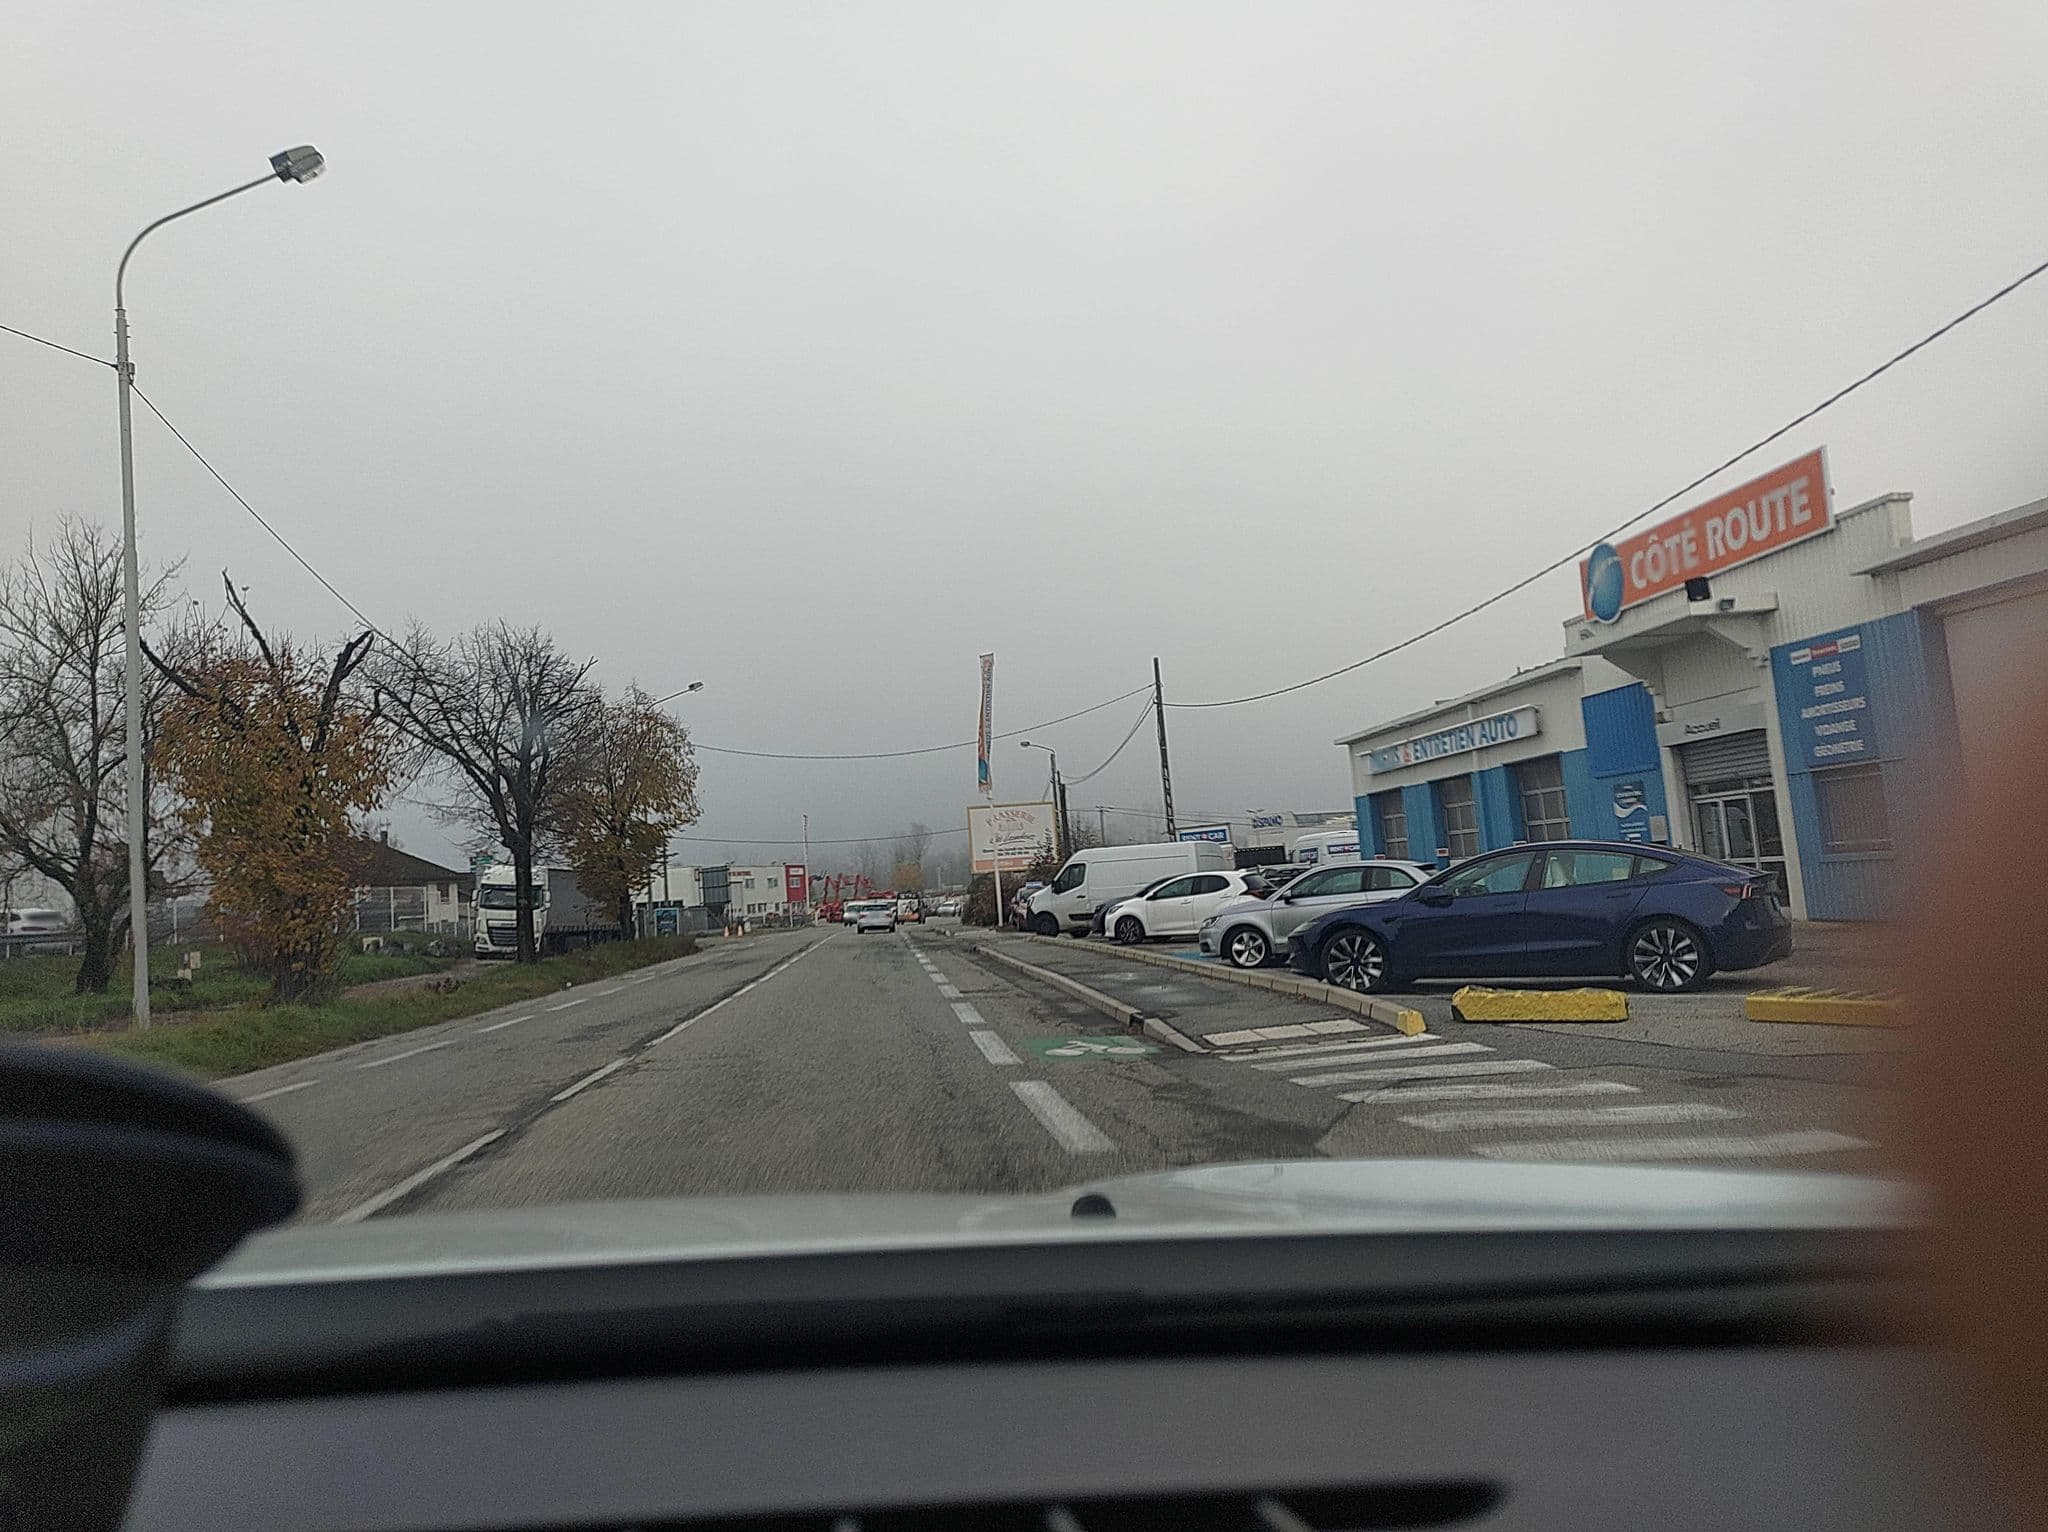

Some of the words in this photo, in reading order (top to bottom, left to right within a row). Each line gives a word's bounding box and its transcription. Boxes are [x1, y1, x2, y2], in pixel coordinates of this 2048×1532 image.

[1630, 519, 1698, 590] CÔTÉ
[1705, 475, 1812, 561] ROUTE
[1685, 718, 1720, 734] Accueil
[1815, 720, 1856, 736] VIDANGE
[1413, 723, 1475, 760] ENTRETIEN
[1479, 714, 1518, 745] AUTO
[1182, 832, 1201, 841] RENT
[1208, 830, 1225, 841] CAR
